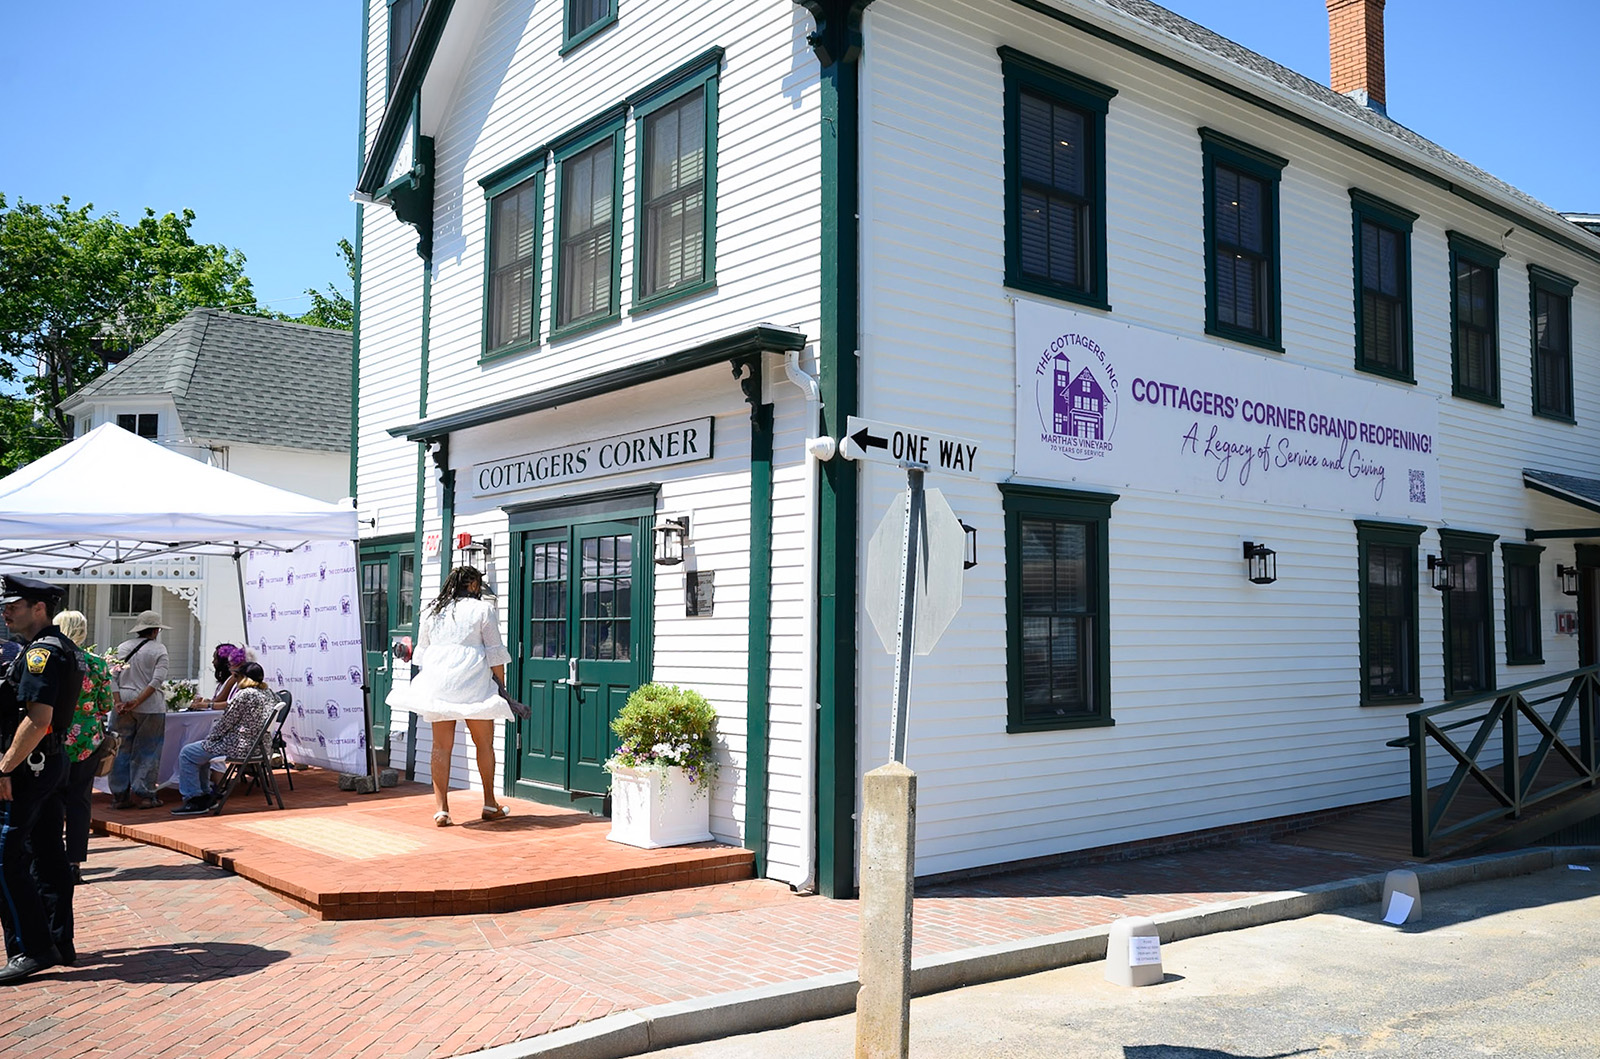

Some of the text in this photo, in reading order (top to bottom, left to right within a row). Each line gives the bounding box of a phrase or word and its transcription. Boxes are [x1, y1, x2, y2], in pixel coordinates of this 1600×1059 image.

[1035, 333, 1119, 393] THE COTTAGERS, INC.
[1041, 433, 1113, 452] MARTHA'S VINEYARD
[1131, 377, 1432, 454] COTTAGERS' CORNER GRAND REOPENING!
[479, 428, 697, 491] COTTAGERS' CORNER
[892, 431, 978, 472] ONE WAY
[1050, 444, 1058, 452] 70
[1058, 446, 1075, 455] YEARS
[1083, 449, 1105, 458] SERVICE
[1181, 422, 1386, 502] A Legacy of Service and Giving
